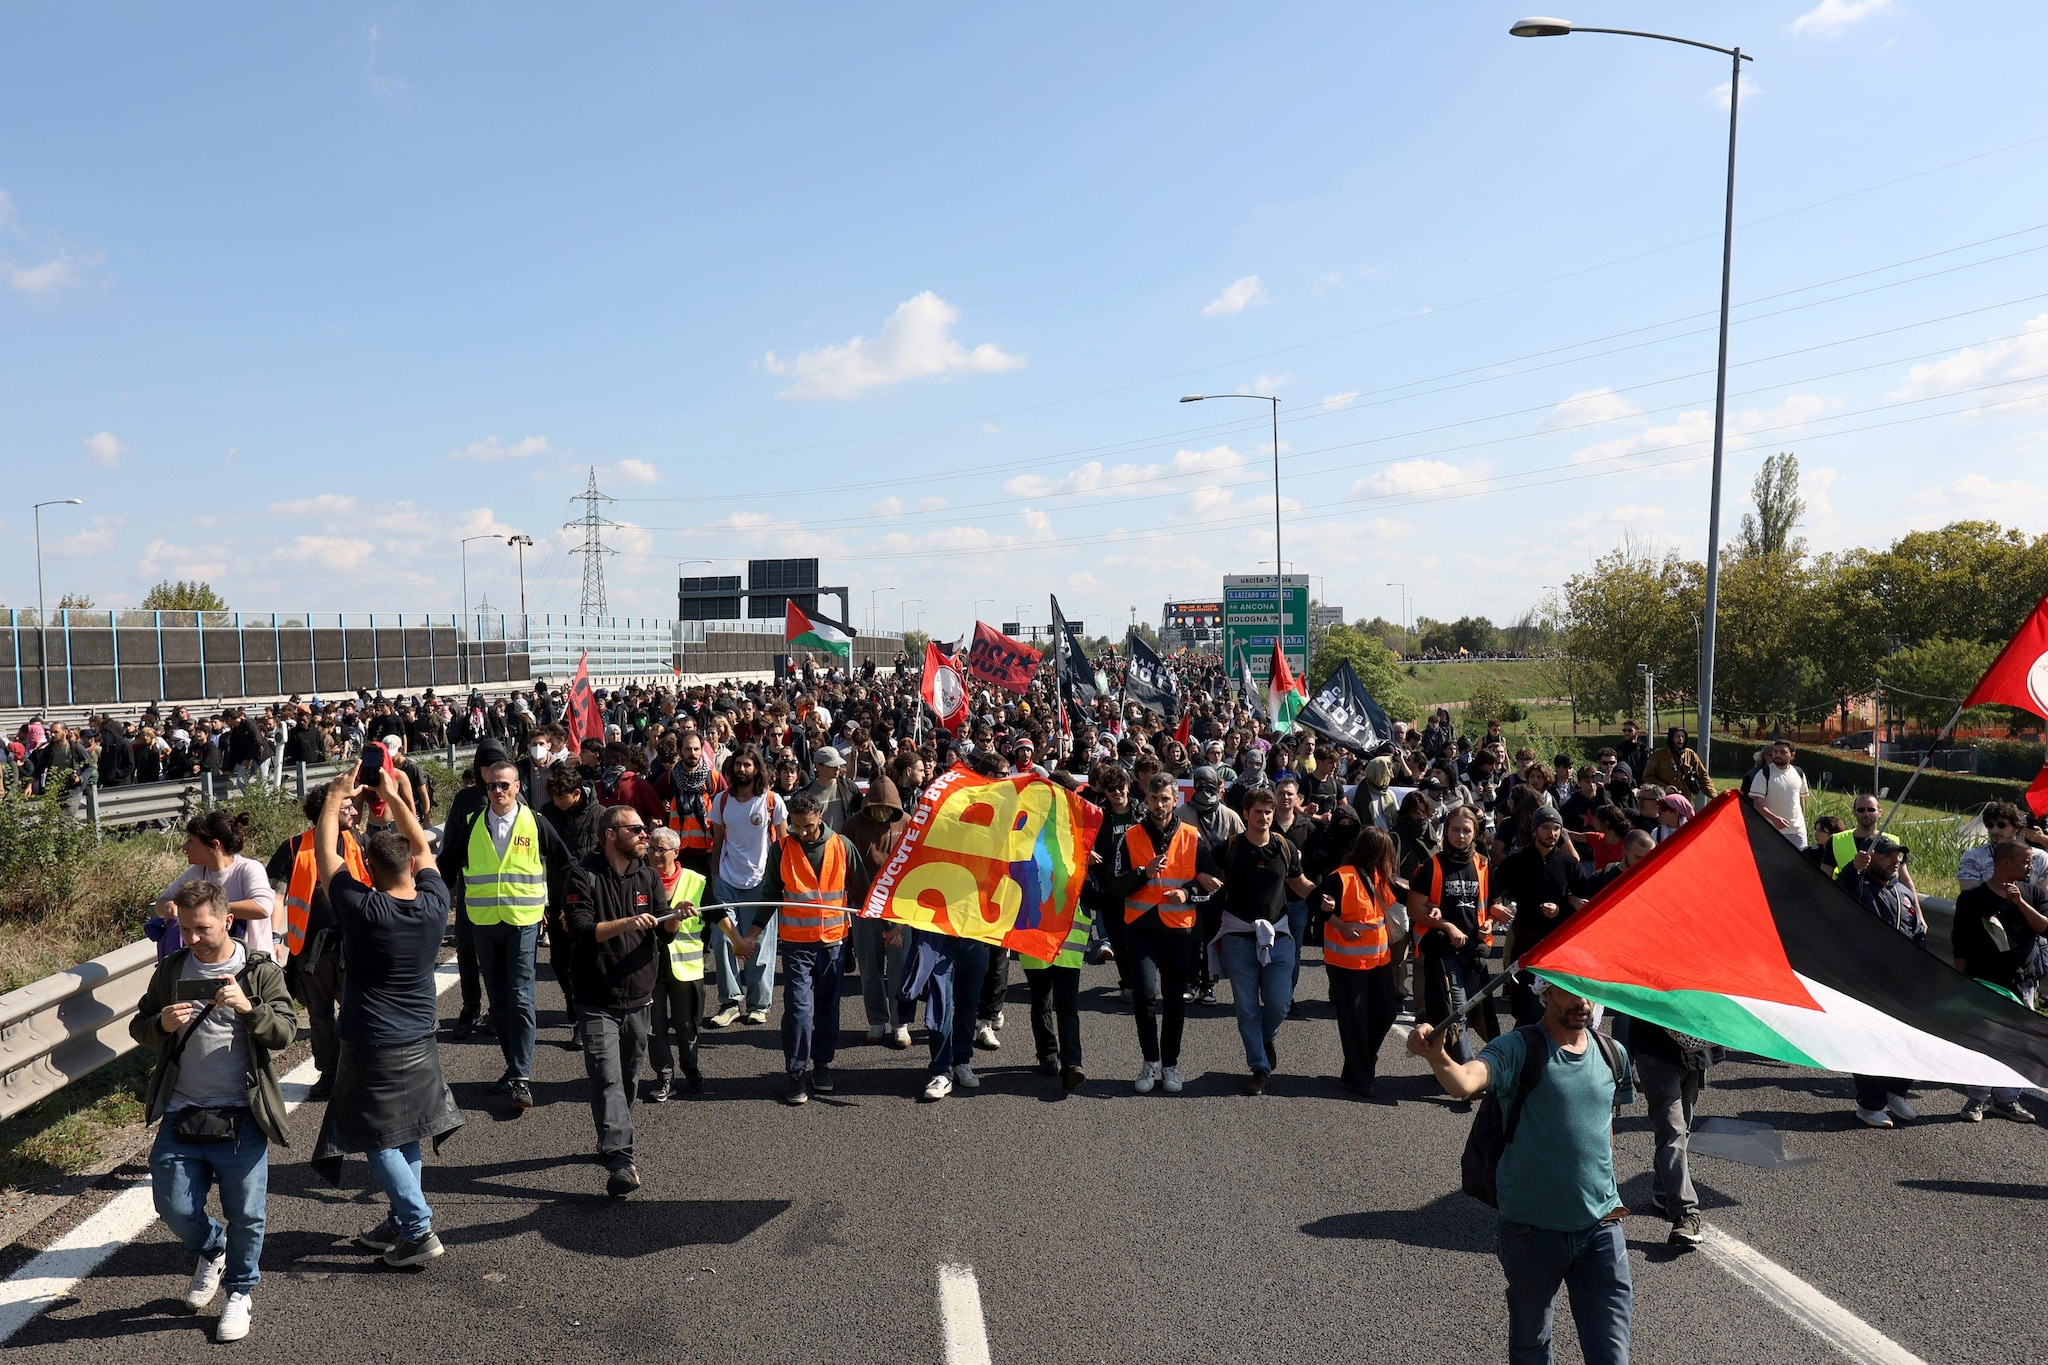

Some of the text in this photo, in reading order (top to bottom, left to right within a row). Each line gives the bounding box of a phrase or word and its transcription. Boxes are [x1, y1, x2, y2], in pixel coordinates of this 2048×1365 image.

[1260, 591, 1268, 599] DI
[1268, 591, 1291, 599] SAVNA
[514, 836, 531, 846] USB
